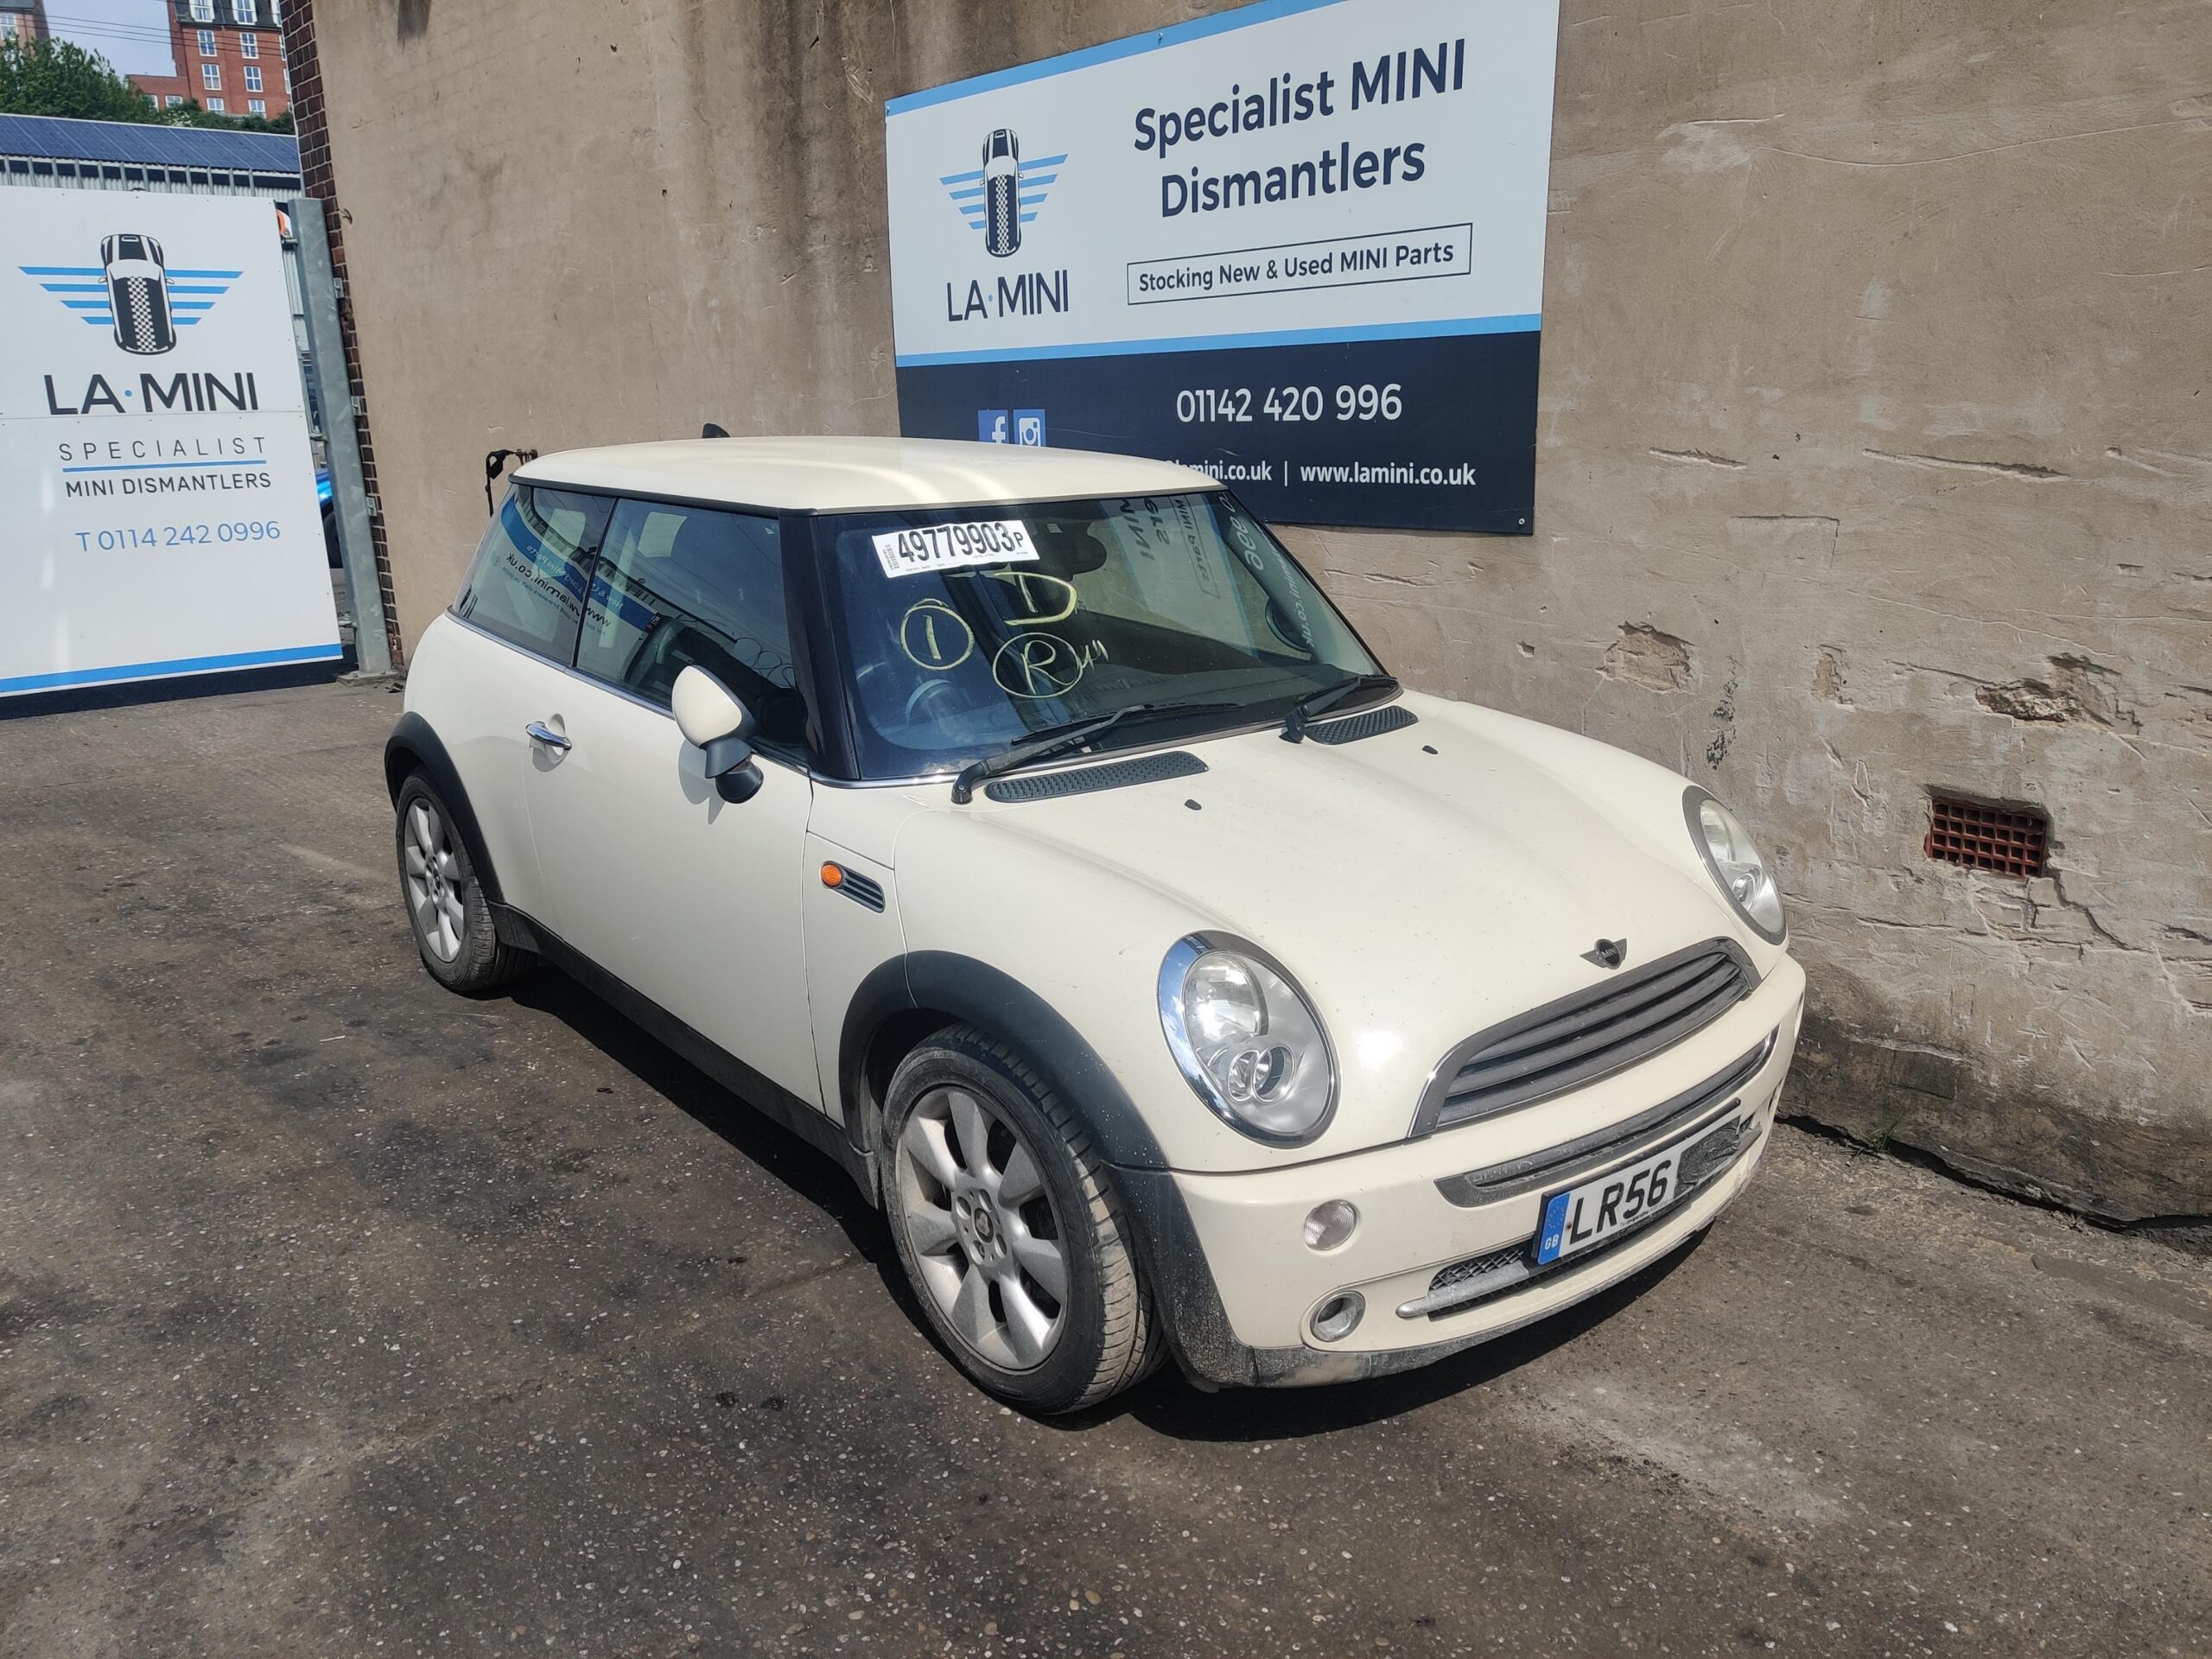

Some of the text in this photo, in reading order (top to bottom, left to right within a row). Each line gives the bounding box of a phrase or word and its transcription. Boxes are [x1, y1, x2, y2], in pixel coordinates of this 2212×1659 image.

[1135, 38, 1465, 158] Specialist MINI
[1161, 141, 1426, 218] Dismantlers
[1139, 242, 1453, 292] Stocking New & Used MINI Parts
[1176, 383, 1402, 423] 01142 420 996
[59, 436, 267, 461] SPECIALIST
[66, 472, 272, 498] MINI DISMANTLERS
[1300, 461, 1477, 486] www.lamini.co.uk
[74, 520, 281, 552] T 0114 242 0996
[898, 522, 1016, 563] 49779903
[1569, 1160, 1672, 1245] LR56
[1544, 1234, 1560, 1250] GB
